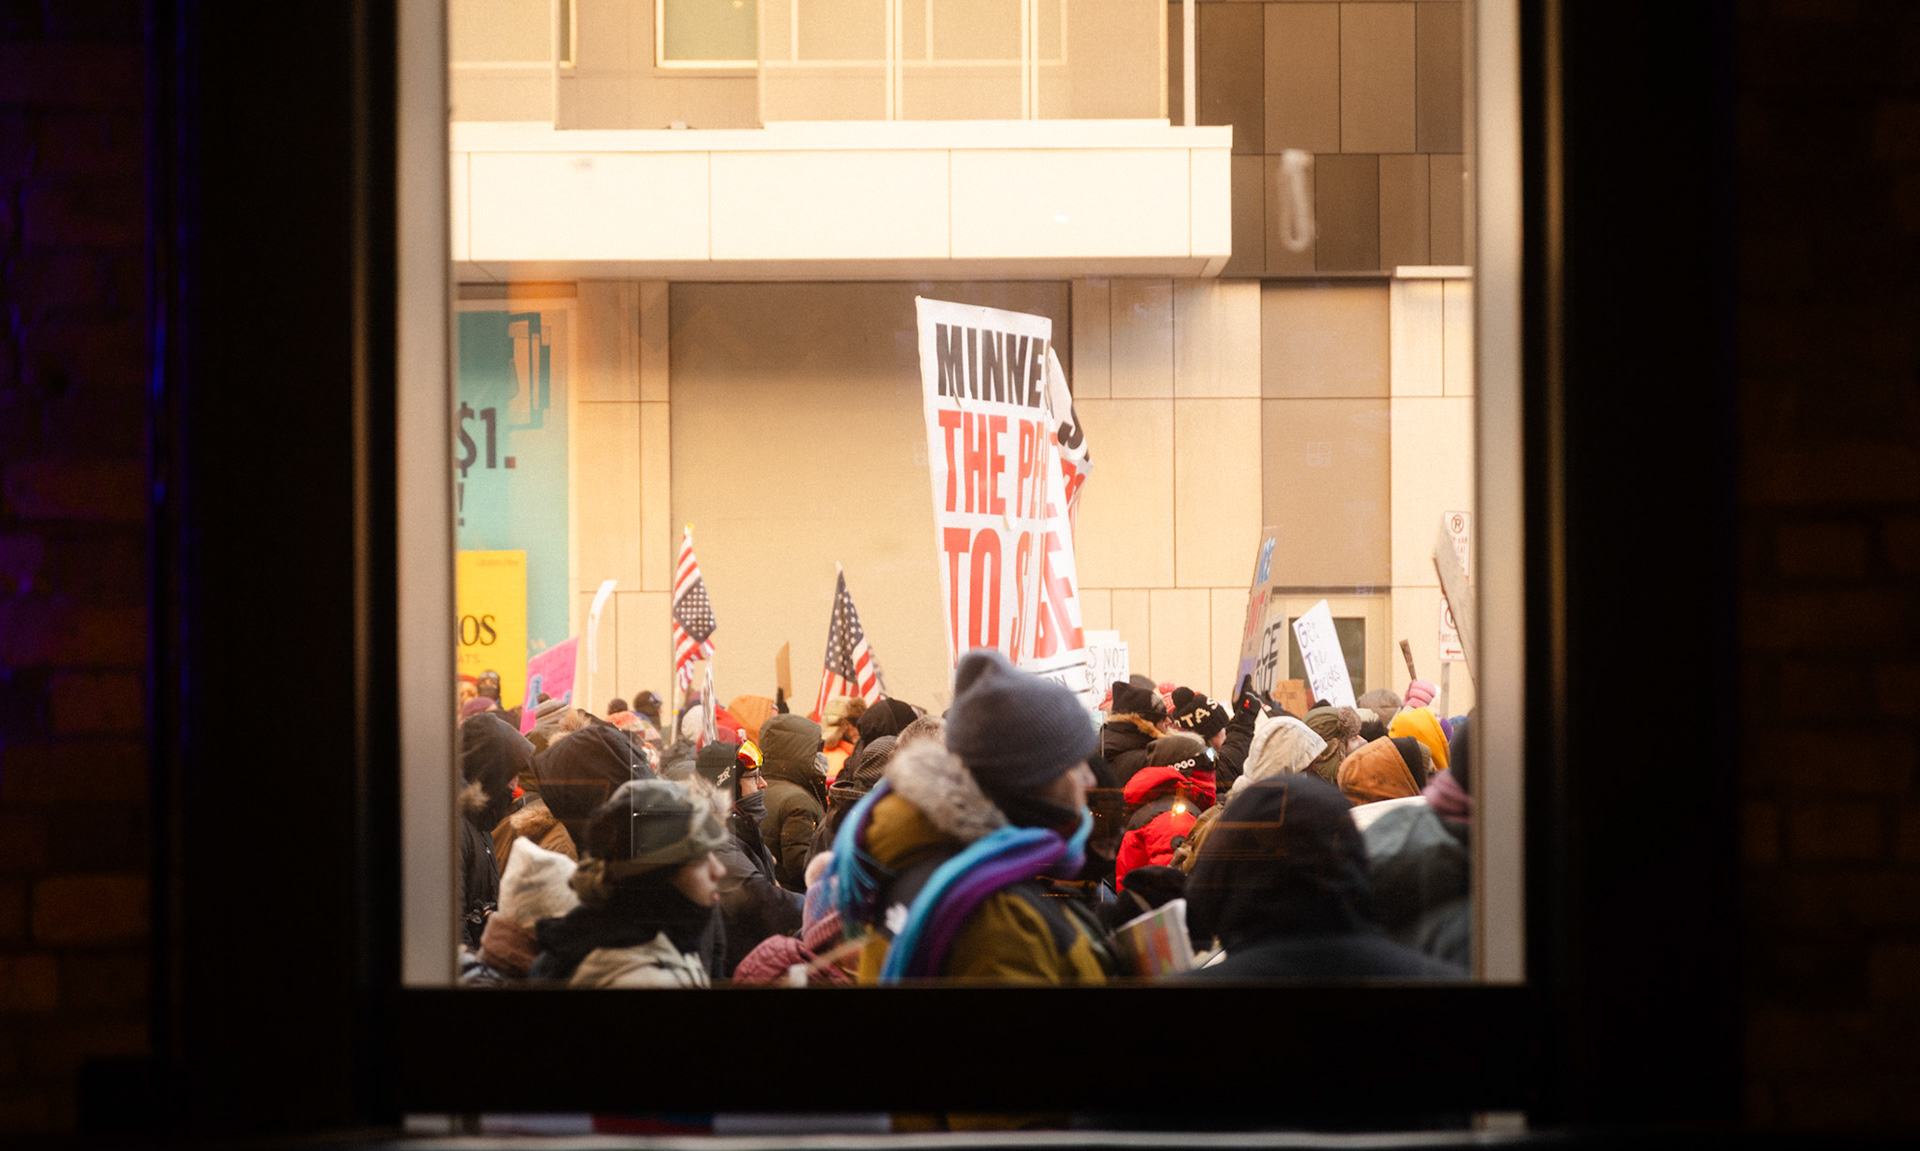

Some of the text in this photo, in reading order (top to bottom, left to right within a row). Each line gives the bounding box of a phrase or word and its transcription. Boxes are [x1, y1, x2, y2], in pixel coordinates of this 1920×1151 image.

[938, 409, 1007, 516] THE
[454, 614, 497, 646] OS
[943, 527, 1002, 668] TO
[1103, 647, 1126, 670] NOT
